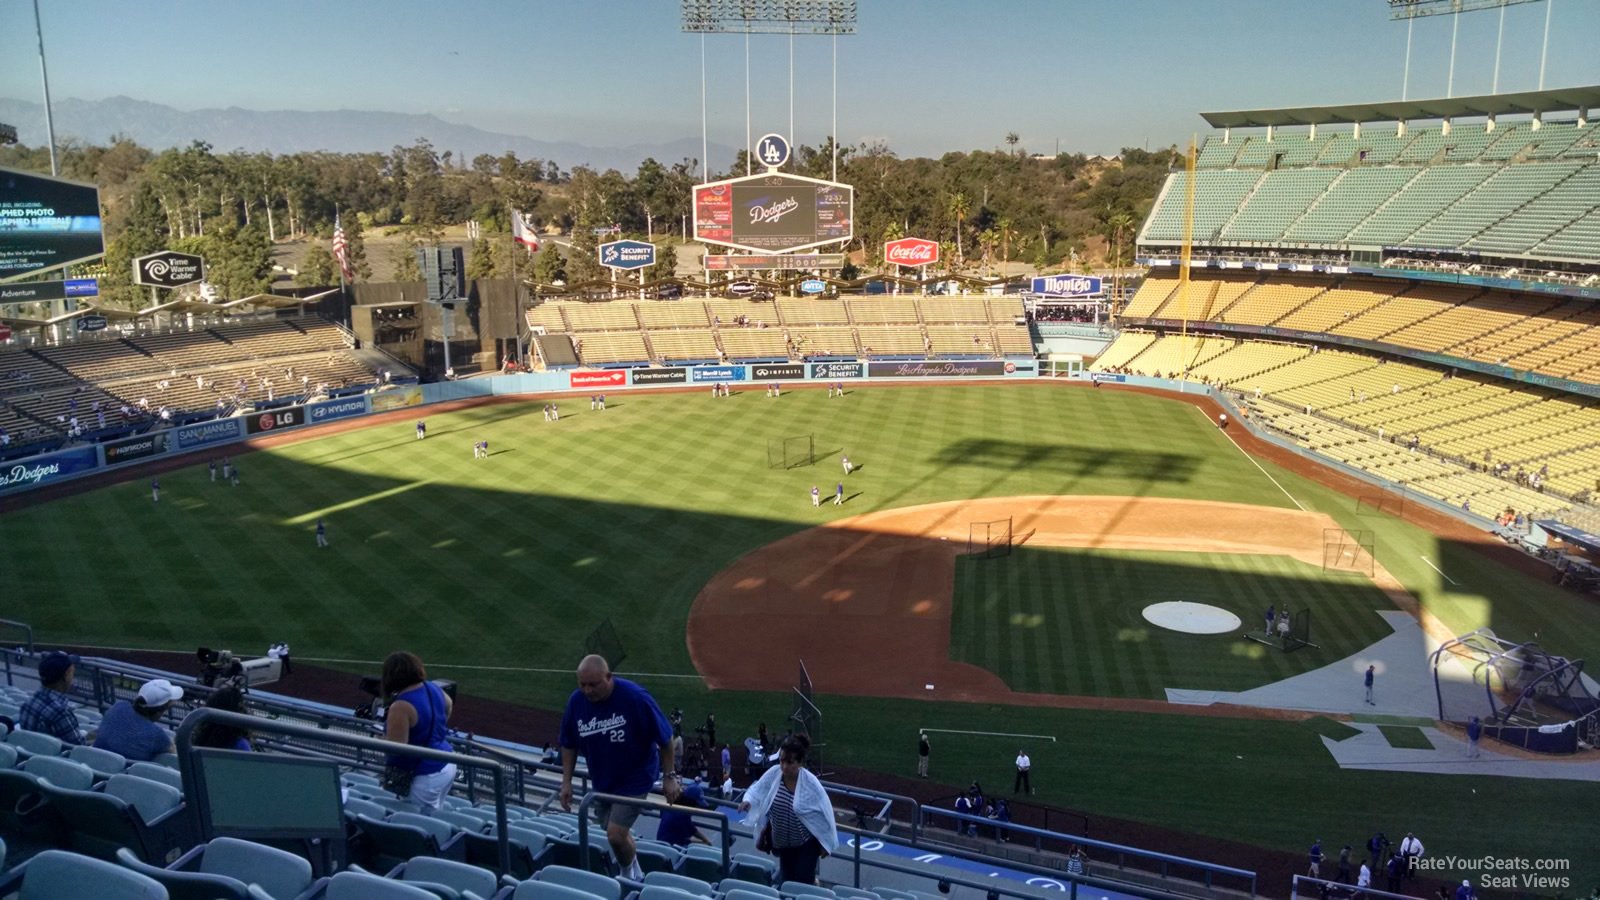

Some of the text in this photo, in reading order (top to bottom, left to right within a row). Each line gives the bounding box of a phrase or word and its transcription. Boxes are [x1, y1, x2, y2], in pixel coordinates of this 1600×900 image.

[764, 139, 780, 162] LA
[764, 178, 783, 186] 5:40
[25, 208, 55, 217] PHOTO
[749, 196, 799, 224] Dodgers
[889, 244, 934, 259] Coca-Cola
[169, 258, 189, 266] Time
[170, 265, 198, 273] Warner
[1044, 278, 1092, 294] Montejo
[1544, 284, 1560, 293] Text
[1, 289, 36, 298] Adventure
[828, 364, 860, 372] SECURITY
[943, 363, 977, 375] Dodgers
[328, 401, 365, 414] HYUNDAI
[276, 412, 294, 425] LG
[179, 429, 198, 440] SAN
[203, 421, 238, 434] MANUEL
[9, 462, 59, 483] Dodgers
[588, 713, 627, 734] Angeles
[609, 729, 625, 742] 22
